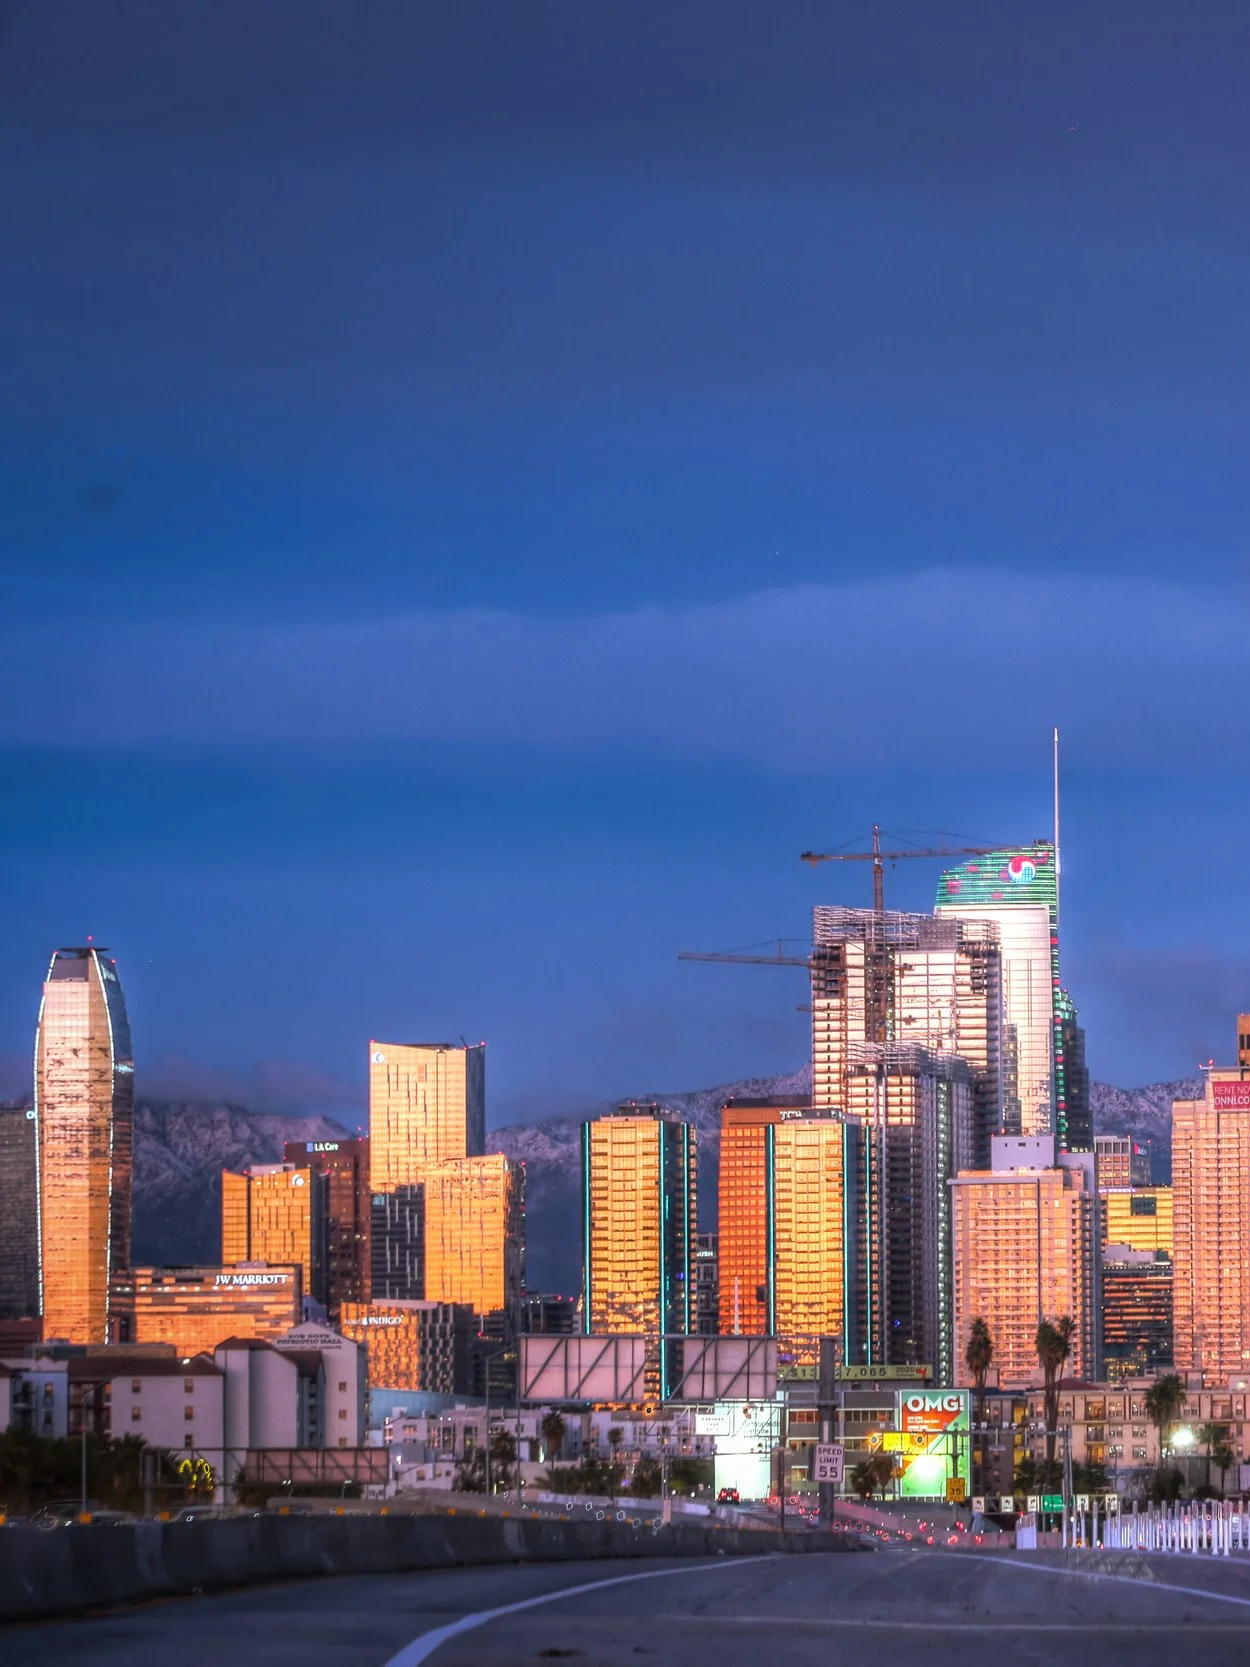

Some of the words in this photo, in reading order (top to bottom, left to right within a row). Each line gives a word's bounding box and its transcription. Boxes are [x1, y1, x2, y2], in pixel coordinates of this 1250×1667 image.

[1214, 1086, 1235, 1095] RENT
[324, 1142, 340, 1151] Care
[215, 1274, 232, 1286] JW
[232, 1274, 289, 1285] MARRIOTT
[367, 1315, 402, 1325] INDIGO
[906, 1394, 965, 1413] OMG!
[818, 1447, 842, 1456] SPEED
[818, 1465, 838, 1478] 55
